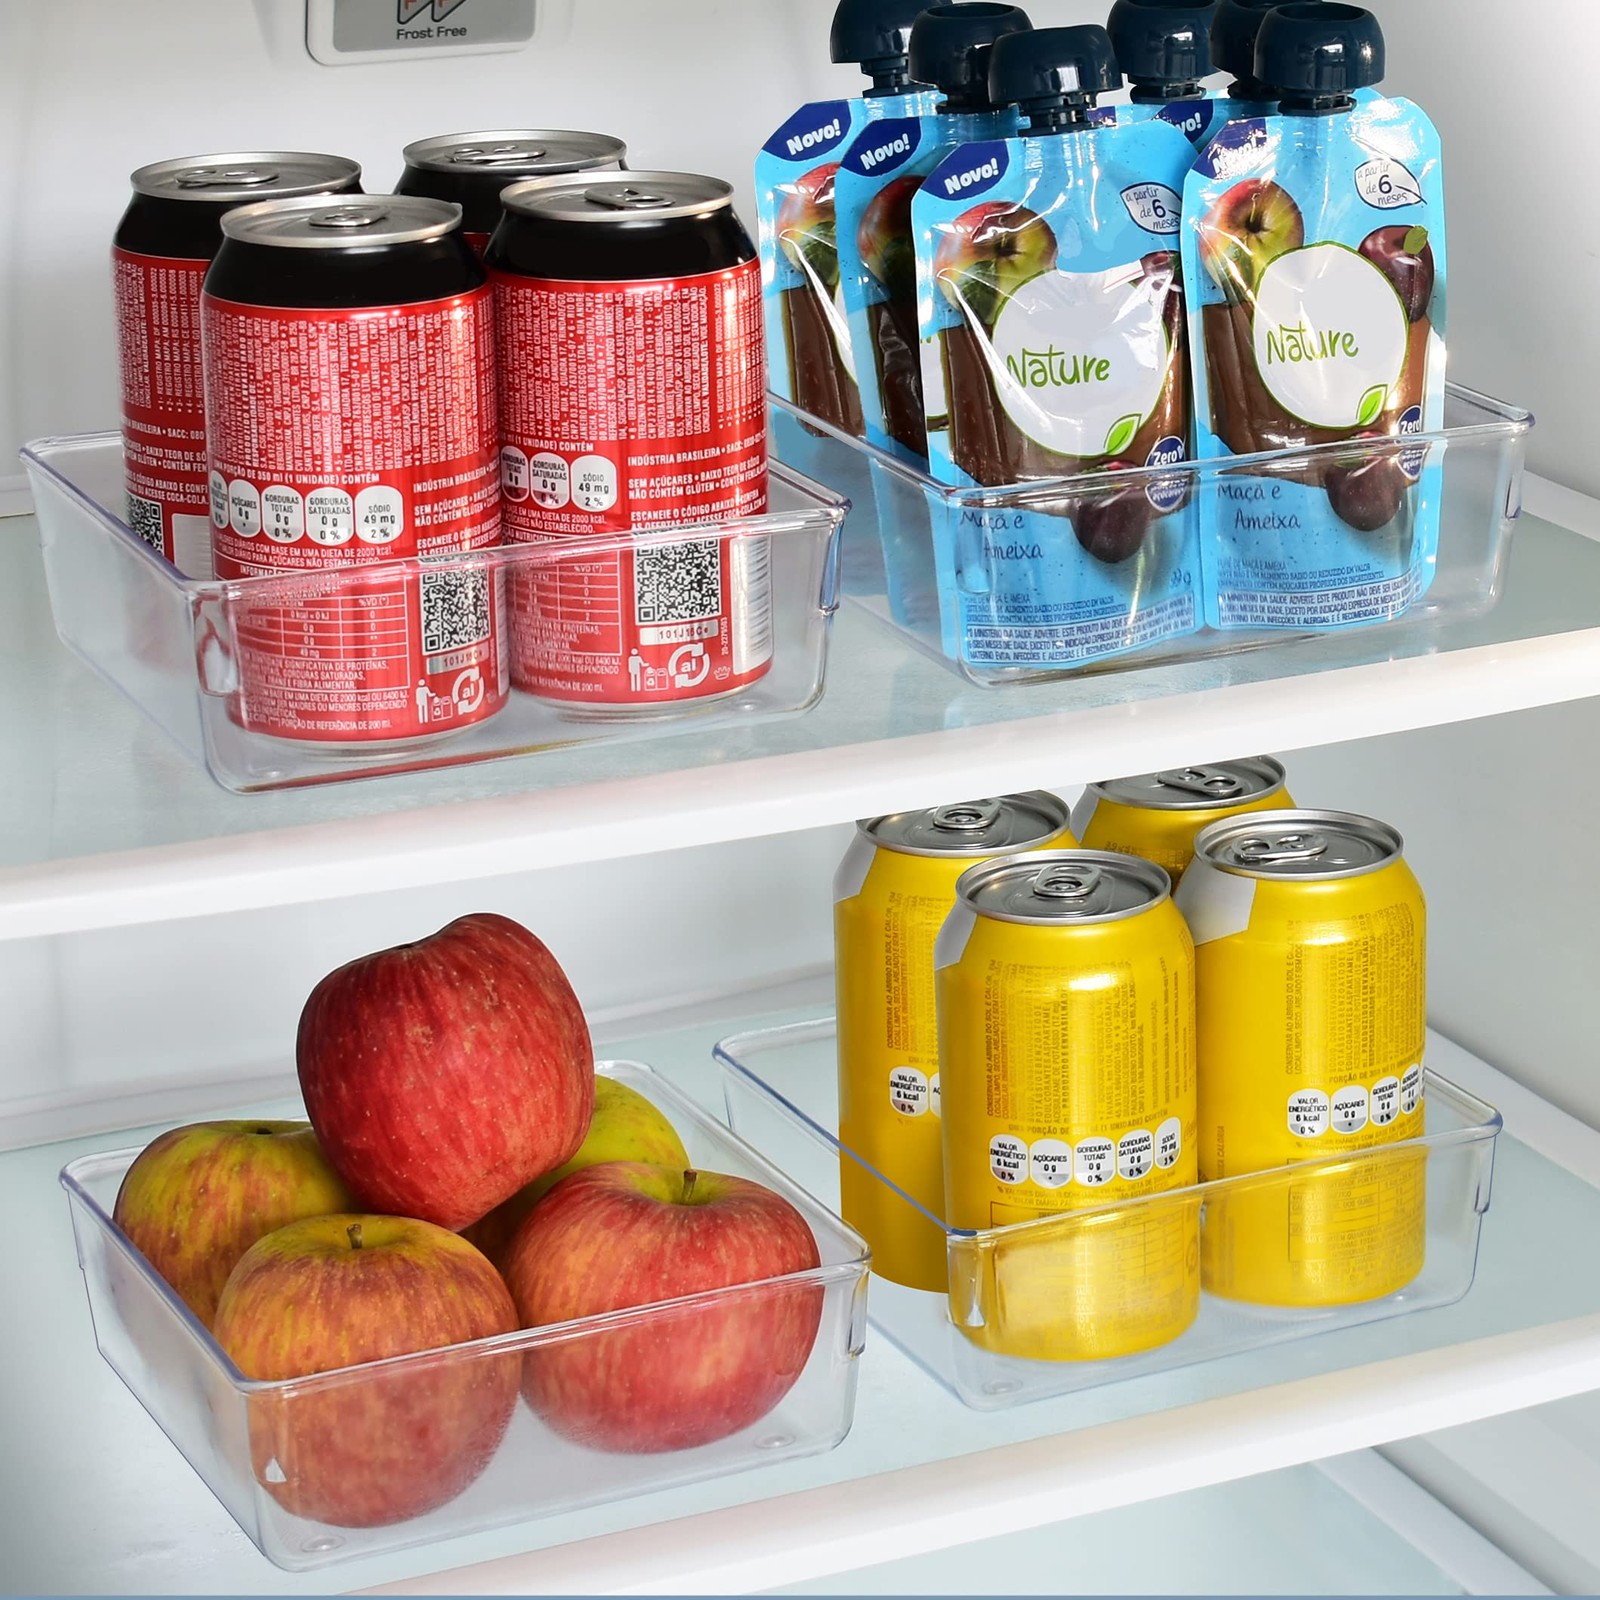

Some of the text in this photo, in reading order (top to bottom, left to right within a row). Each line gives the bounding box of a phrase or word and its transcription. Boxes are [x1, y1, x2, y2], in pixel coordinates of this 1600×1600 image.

[397, 27, 467, 40] Frost Free
[786, 118, 841, 155] Novo!
[860, 133, 911, 170] Novo!
[944, 158, 999, 195] Novo!
[1365, 161, 1391, 181] partir
[1366, 174, 1392, 194] de 6
[1125, 186, 1159, 205] a partir
[1378, 192, 1408, 206] meses
[1140, 199, 1166, 219] de 6
[1153, 217, 1180, 230] meses
[1266, 320, 1359, 365] Nature
[1006, 344, 1110, 388] Nature
[522, 438, 594, 452] UNIDADE) CONTÉM
[164, 449, 182, 461] TEOR
[183, 451, 194, 461] DE
[627, 453, 675, 467] INDÚSTRIA
[676, 446, 721, 463] BRASILEIRA
[533, 460, 566, 471] GORDURAS
[246, 469, 256, 479] DE
[257, 471, 271, 482] 350
[295, 473, 339, 485] UNIDADE)
[341, 472, 380, 485] CONTÉM
[413, 476, 454, 493] INDÚSTRIA
[455, 468, 487, 485] BRASILEIRA
[532, 469, 567, 480] SATURADAS
[583, 472, 605, 482] SÓDIO
[628, 478, 647, 489] SEM
[649, 473, 693, 490] AÇÚCARES
[700, 468, 721, 480] BAIXO
[723, 463, 739, 476] TEOR
[542, 479, 548, 489] 0
[578, 482, 609, 494] 49 mg
[628, 488, 647, 500] NÃO
[649, 485, 684, 499] CONTÉM
[685, 481, 715, 495] GLÚTEN
[1217, 483, 1281, 503] Maçã e
[265, 494, 299, 505] GORDURAS
[309, 497, 349, 506] GORDURAS
[414, 495, 469, 516] SEM AÇÚCARES
[585, 497, 603, 507] 2 %
[271, 504, 294, 513] TOTAIS
[308, 506, 351, 515] SATURADAS
[368, 504, 391, 513] SÓDIO
[415, 502, 484, 527] NÃO CONTÉM GLÚTEN
[631, 498, 734, 522] ESCANEIE O CÓDIGO ABAIXO
[276, 513, 289, 526] 0 g
[321, 515, 338, 527] 0 g
[364, 514, 395, 524] 49 mg
[542, 511, 559, 522] DIETA
[561, 513, 571, 523] DE
[572, 514, 589, 524] 2000
[1013, 515, 1024, 529] e
[1234, 510, 1301, 530] Ameixa
[274, 528, 292, 539] 0 %
[320, 530, 341, 540] 0 %
[371, 527, 390, 539] 2 %
[417, 531, 459, 550] ESCANEIE O
[255, 543, 270, 553] COM
[271, 545, 289, 555] BASE
[289, 547, 301, 556] EM
[302, 549, 319, 558] UMA
[321, 549, 343, 558] DIETA
[344, 549, 355, 557] DE
[356, 547, 375, 557] 2000
[983, 536, 1044, 560] Ameixa
[898, 1074, 918, 1083] VALOR
[890, 1080, 926, 1093] ENERGÉTICO
[903, 1091, 920, 1101] kcal
[1297, 1097, 1319, 1105] VALOR
[1289, 1103, 1328, 1112] ENERGÉTICO
[1334, 1099, 1365, 1111] AÇÚCARES
[1303, 1113, 1320, 1122] kcal
[1300, 1126, 1315, 1134] 0 %
[998, 1142, 1018, 1151] VALOR
[1076, 1143, 1112, 1153] GORDURAS
[1119, 1135, 1151, 1149] GORDURAS
[990, 1148, 1026, 1160] ENERGÉTICO
[1118, 1143, 1152, 1157] SATURADAS
[1033, 1154, 1068, 1163] AÇÚCARES
[1083, 1153, 1106, 1161] TOTAIS
[1003, 1159, 1019, 1169] kcal
[1096, 1163, 1101, 1171] g
[1008, 1172, 1015, 1181] %
[1094, 1174, 1102, 1182] %
